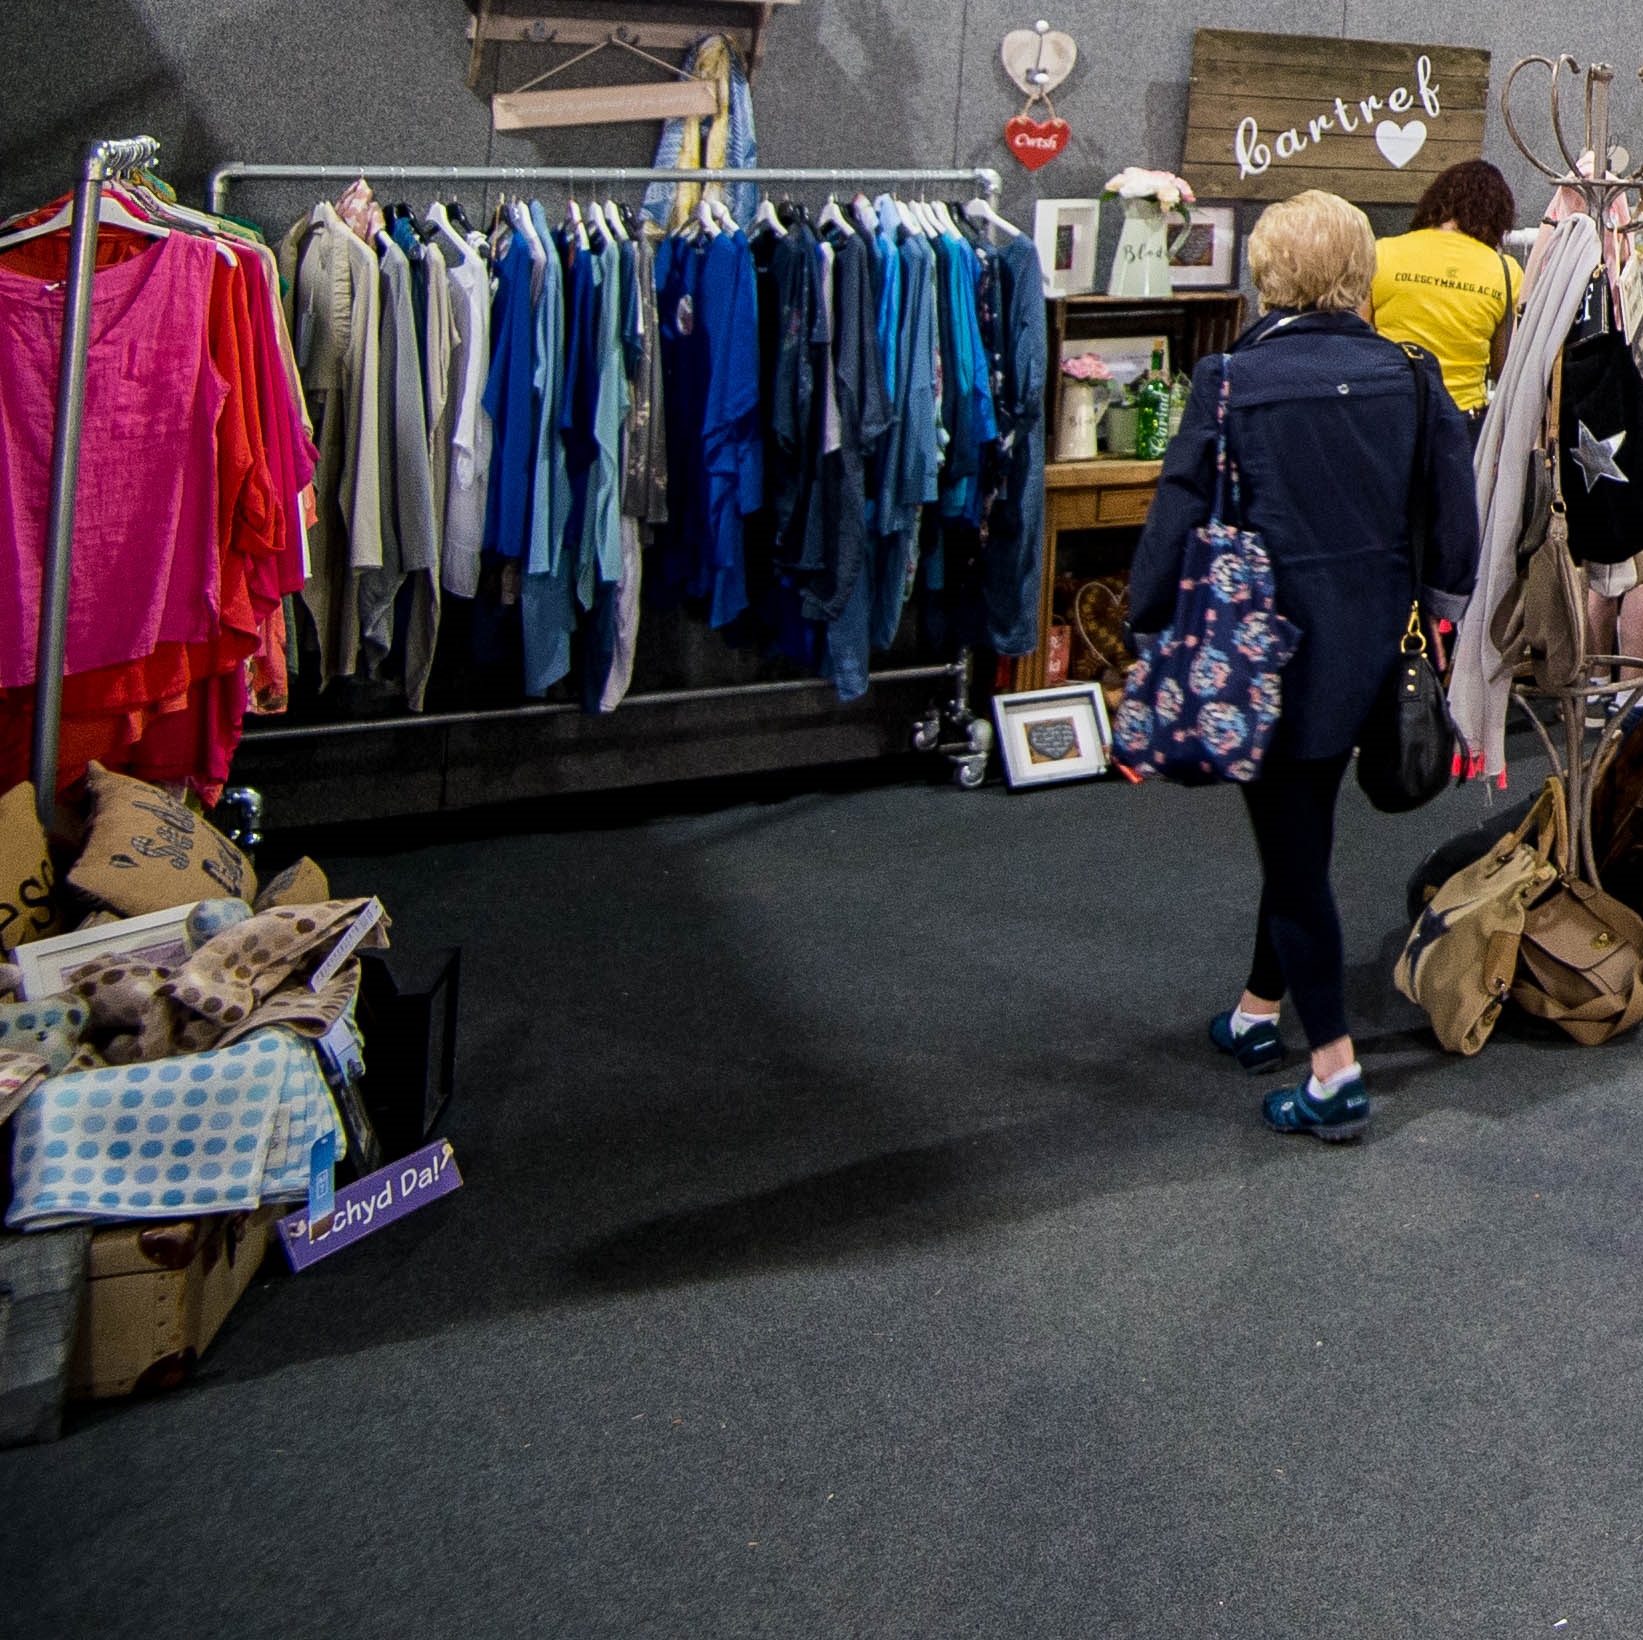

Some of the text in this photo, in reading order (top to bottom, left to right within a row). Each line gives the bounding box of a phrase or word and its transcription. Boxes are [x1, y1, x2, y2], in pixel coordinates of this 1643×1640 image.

[1015, 133, 1058, 150] Cwtsh
[1234, 55, 1440, 180] cartref
[309, 1179, 393, 1245] chyd
[400, 1155, 440, 1199] Da!
